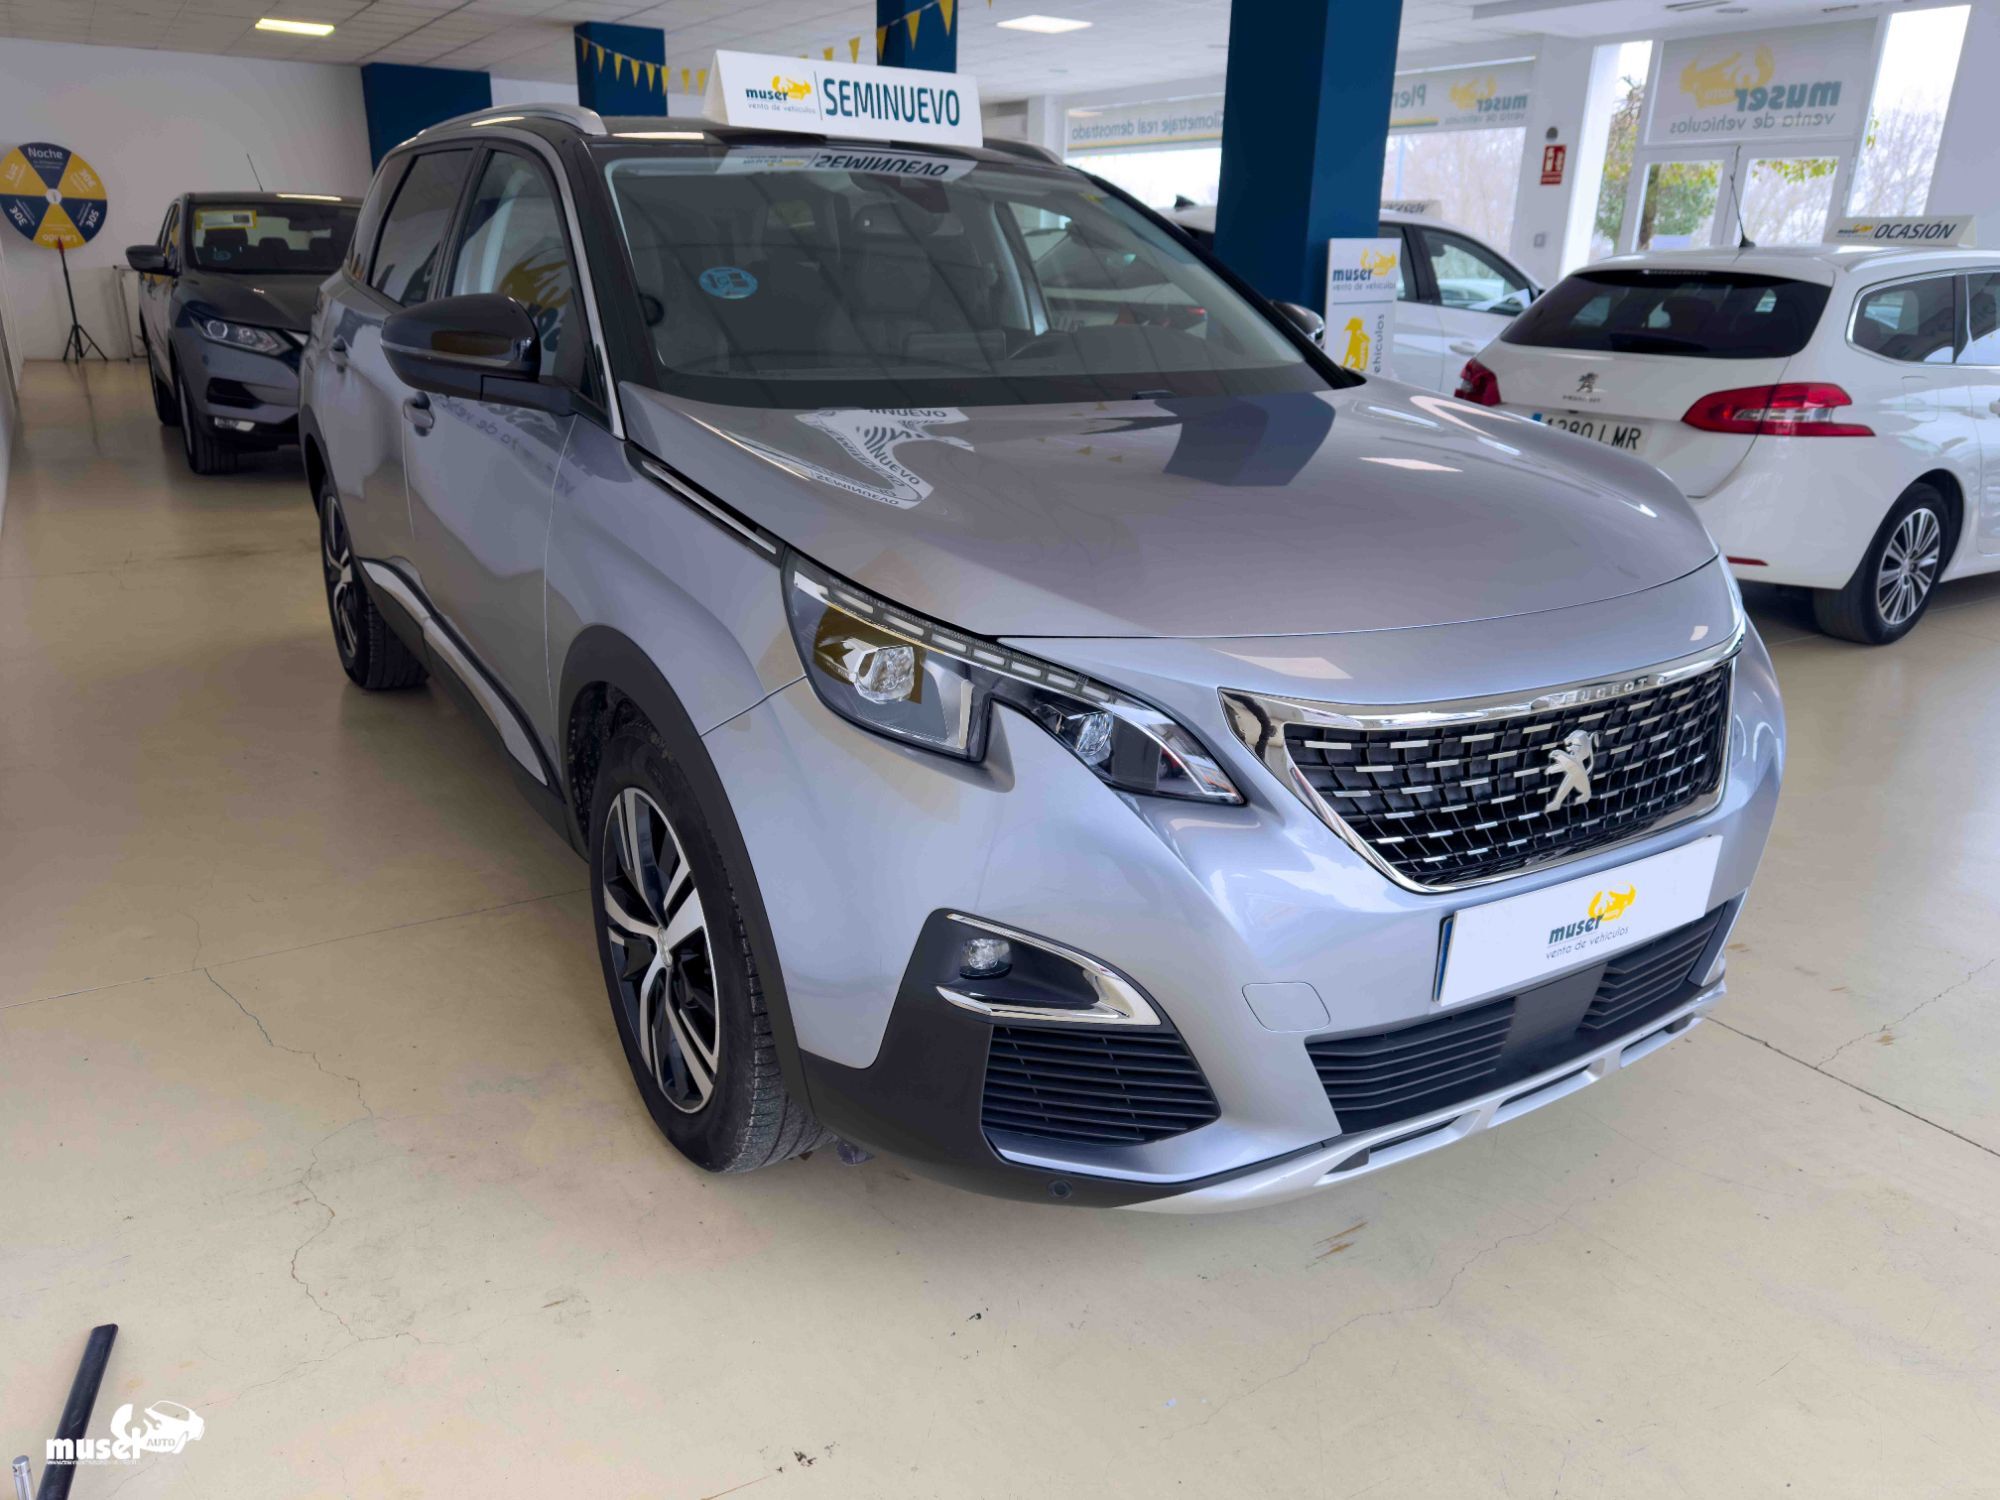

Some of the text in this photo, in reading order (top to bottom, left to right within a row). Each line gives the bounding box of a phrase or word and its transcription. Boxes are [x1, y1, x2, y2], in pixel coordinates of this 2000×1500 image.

[745, 88, 788, 101] muser
[823, 78, 960, 127] SEMINUEVO
[27, 147, 63, 159] Noche
[1874, 220, 1957, 239] OCASIÓN
[1333, 268, 1373, 281] muser
[1549, 914, 1604, 944] muser
